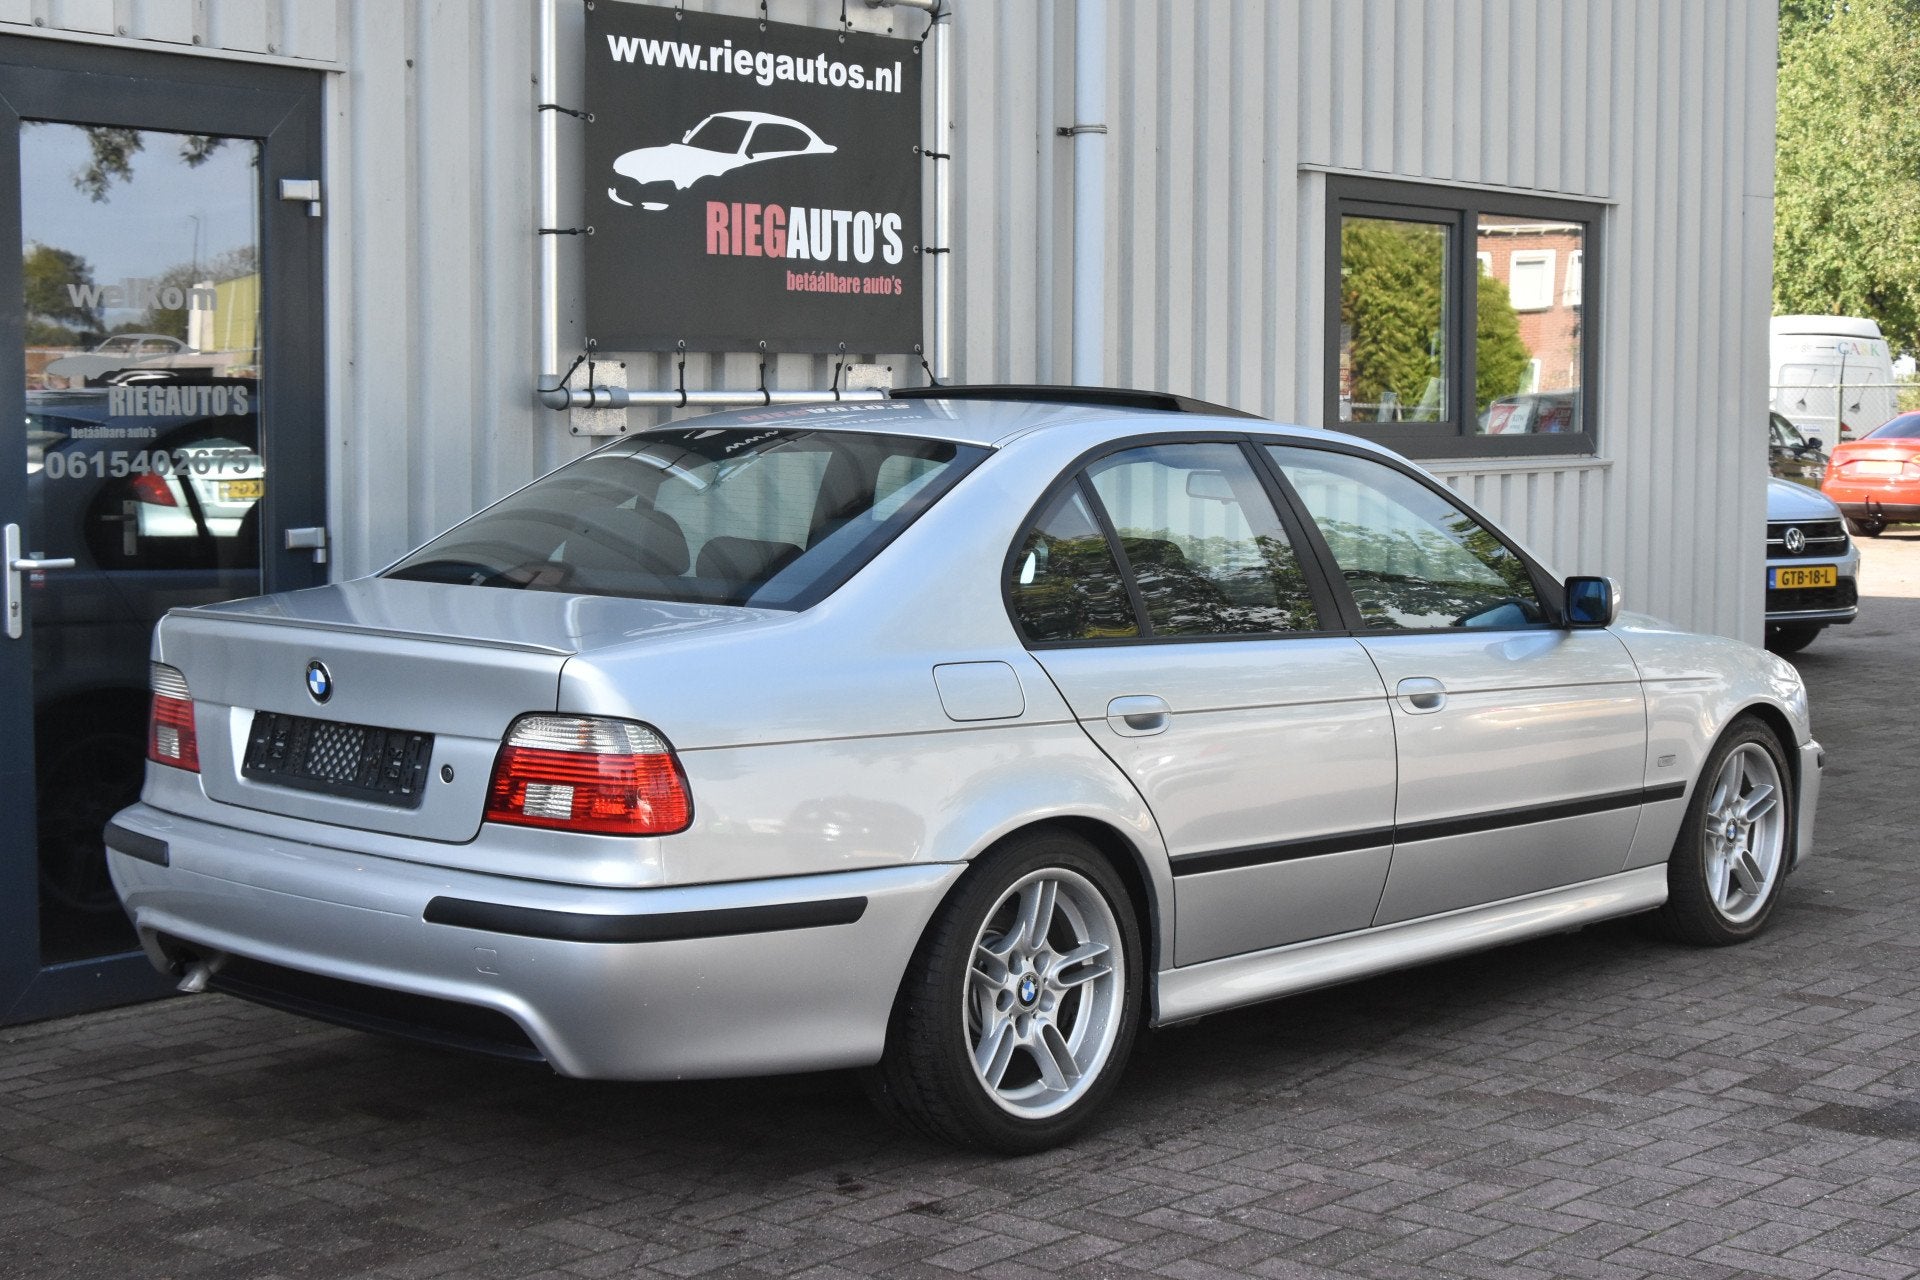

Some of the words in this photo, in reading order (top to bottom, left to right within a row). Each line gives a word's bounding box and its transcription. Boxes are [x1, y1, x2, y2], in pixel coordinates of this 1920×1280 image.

[607, 35, 901, 93] www.riegautos.nl
[706, 201, 903, 265] RIEGAUTO'S
[786, 270, 861, 294] betáálbare
[863, 275, 902, 295] auto's
[108, 385, 249, 416] RIEGAUTO'S
[45, 449, 251, 479] 0615402675
[1781, 569, 1831, 586] GTB-18-L
